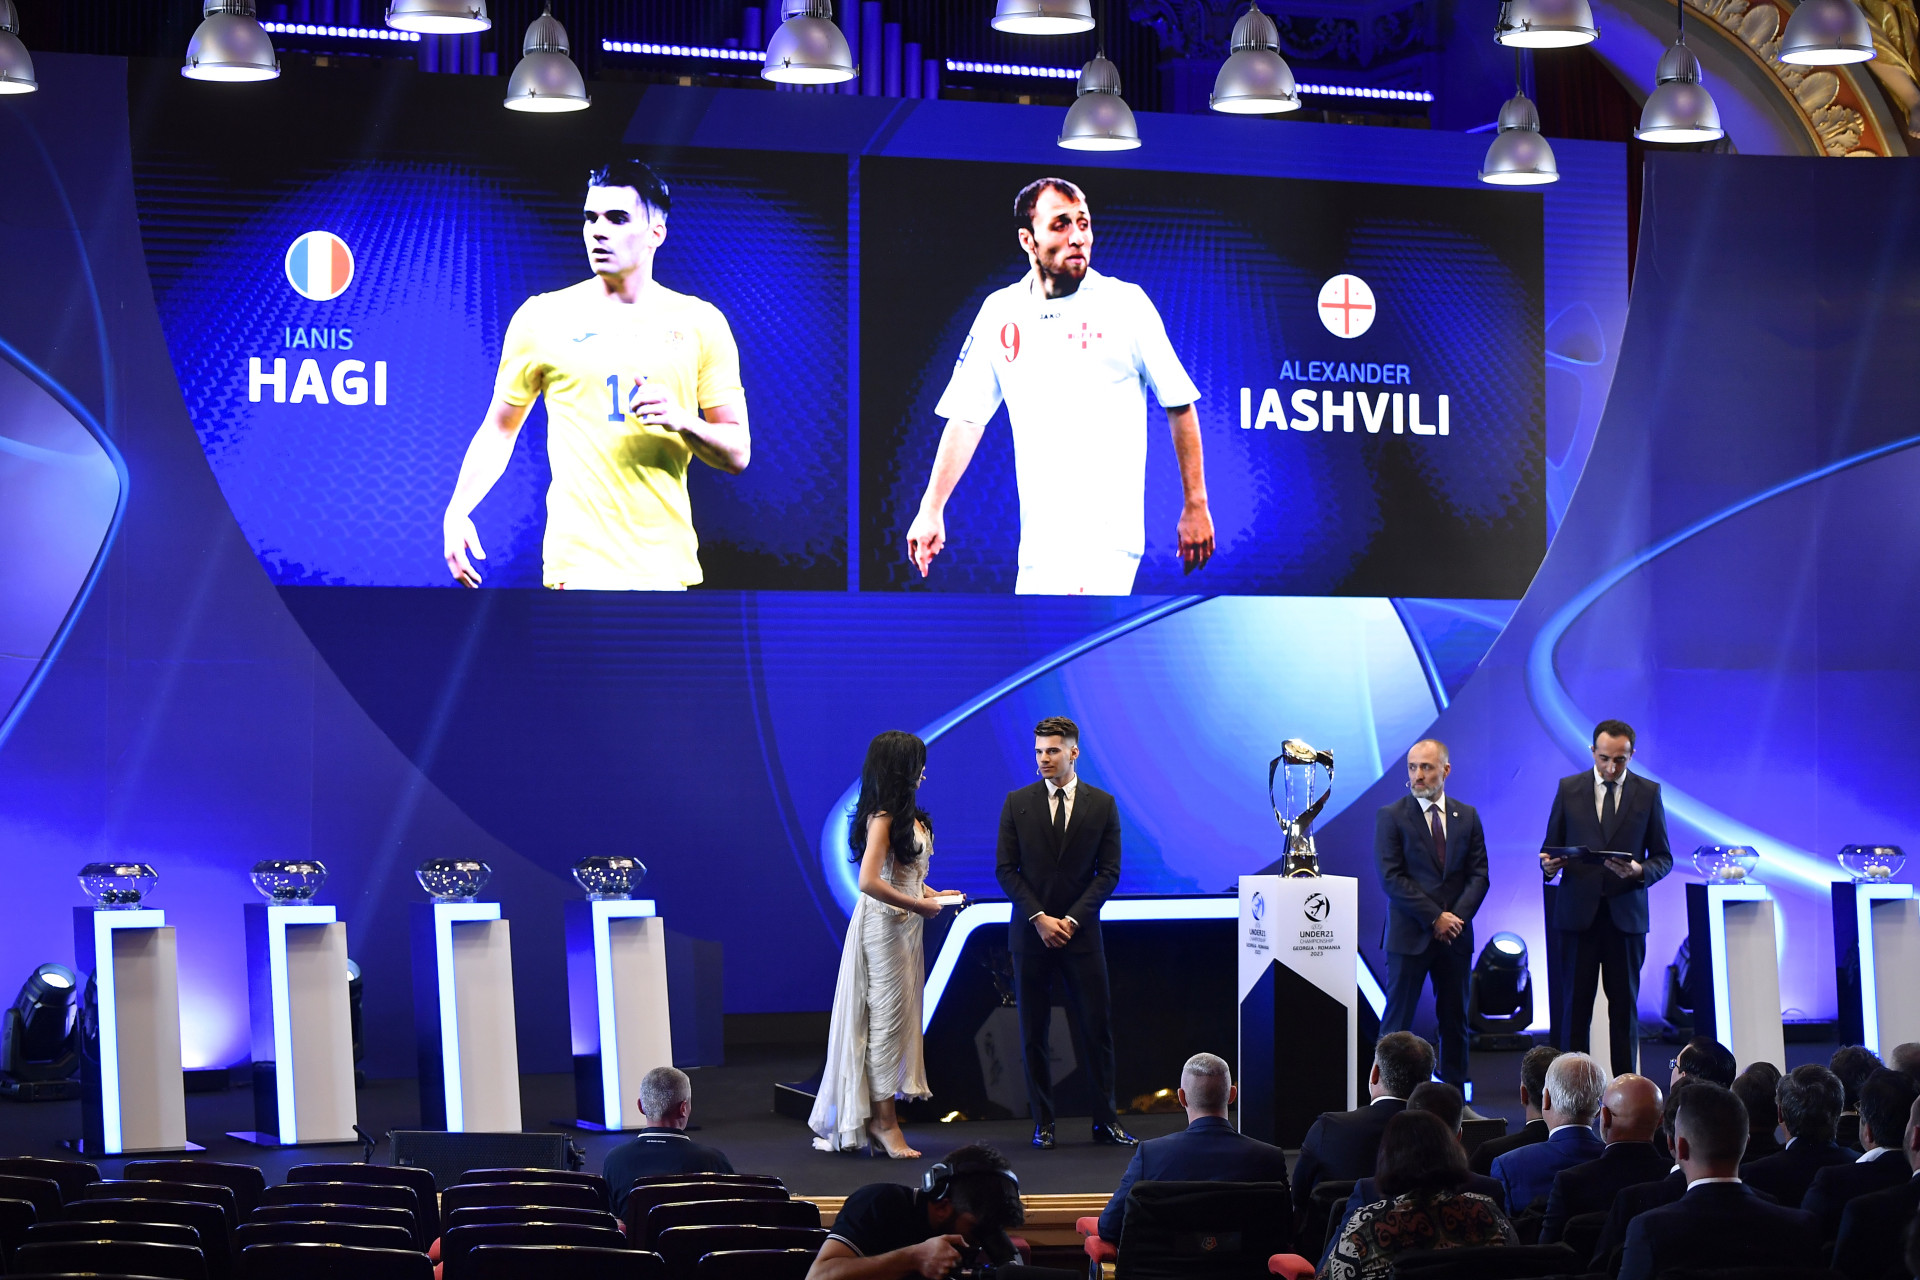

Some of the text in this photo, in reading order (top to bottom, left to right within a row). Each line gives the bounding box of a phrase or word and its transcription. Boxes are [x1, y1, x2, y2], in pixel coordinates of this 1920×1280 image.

[285, 326, 354, 351] IANIS
[1000, 322, 1020, 363] 9
[248, 356, 388, 406] HAGI
[1279, 360, 1411, 385] ALEXANDER
[1240, 387, 1450, 436] IASHVILI
[1299, 930, 1334, 938] UNDER21
